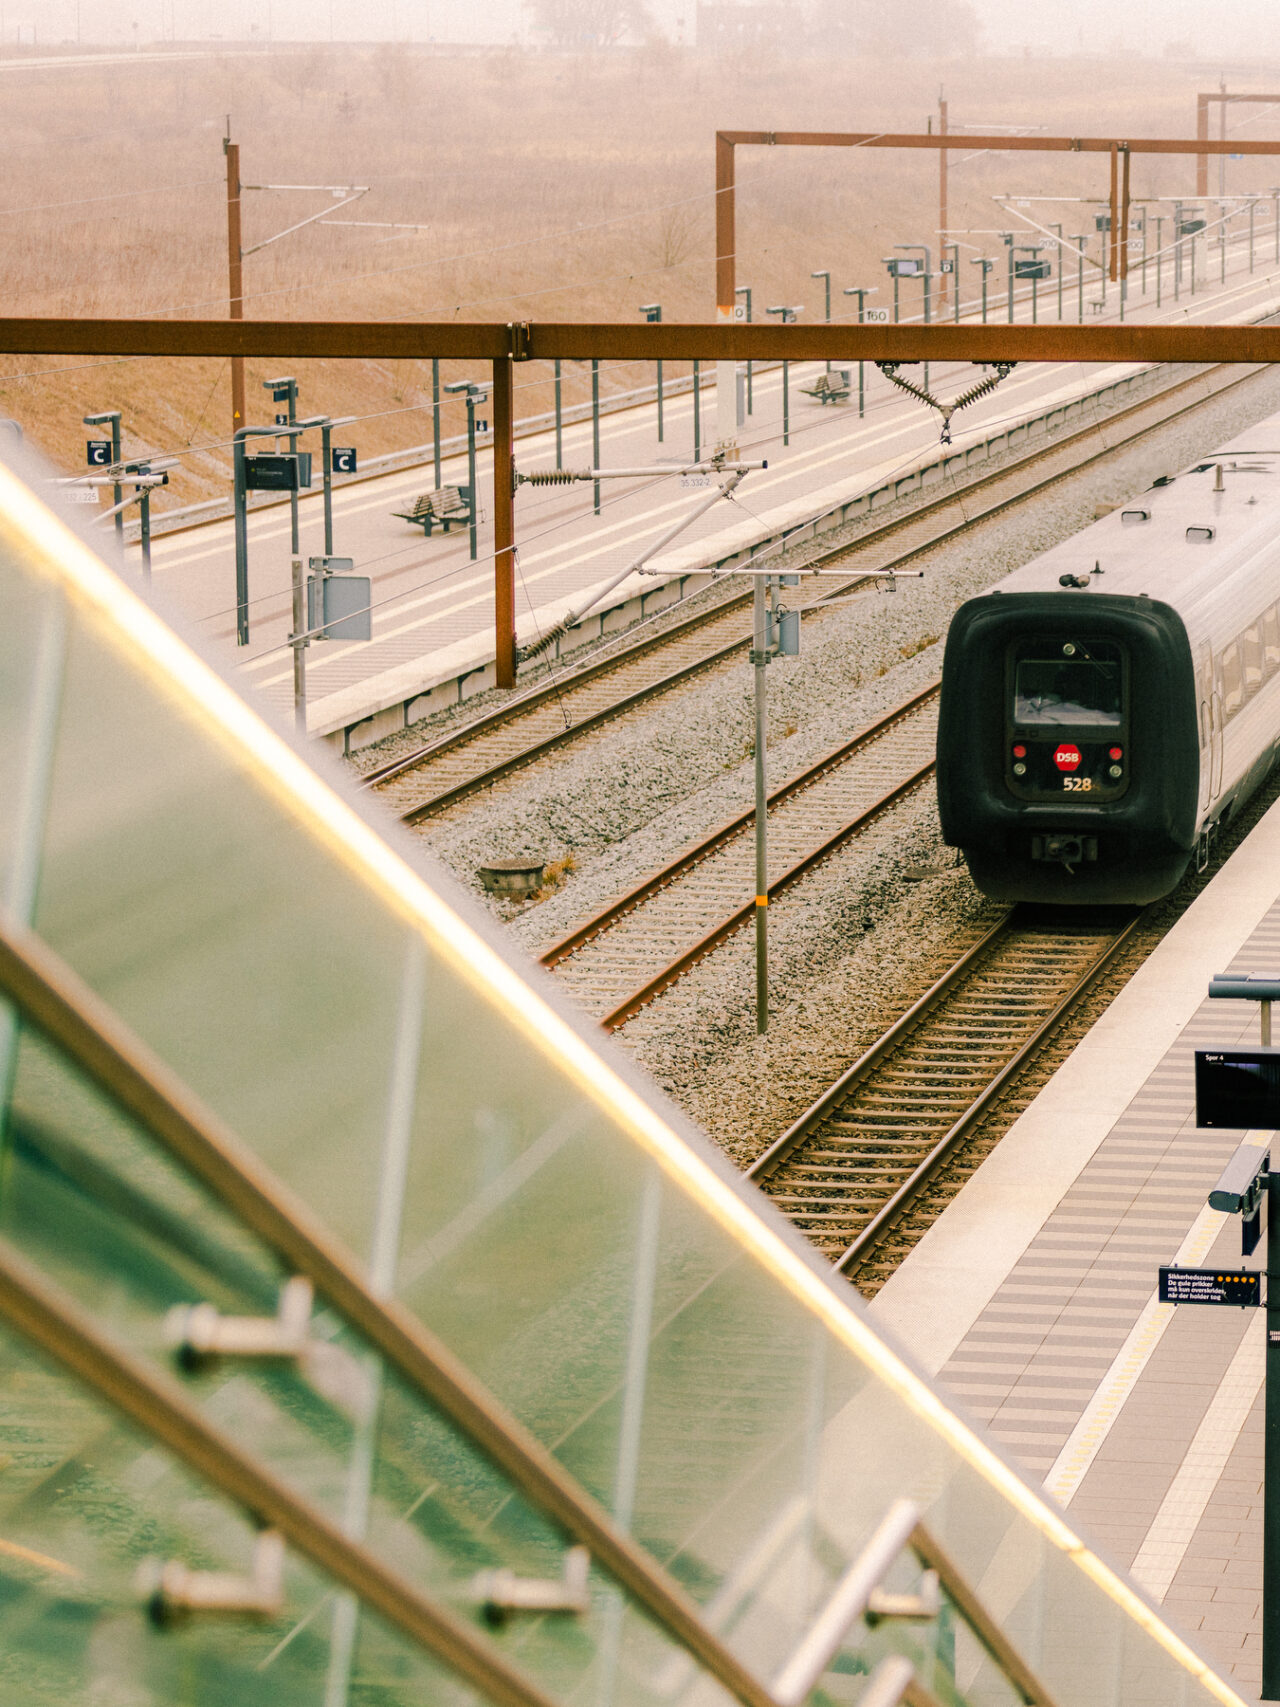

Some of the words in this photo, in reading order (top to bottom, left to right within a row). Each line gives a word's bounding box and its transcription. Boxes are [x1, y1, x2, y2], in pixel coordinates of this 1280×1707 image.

[94, 449, 104, 463] C
[339, 456, 350, 471] C
[1056, 752, 1079, 762] DSB
[1063, 777, 1092, 791] 528
[1167, 1273, 1215, 1281] Sikkerhedszone
